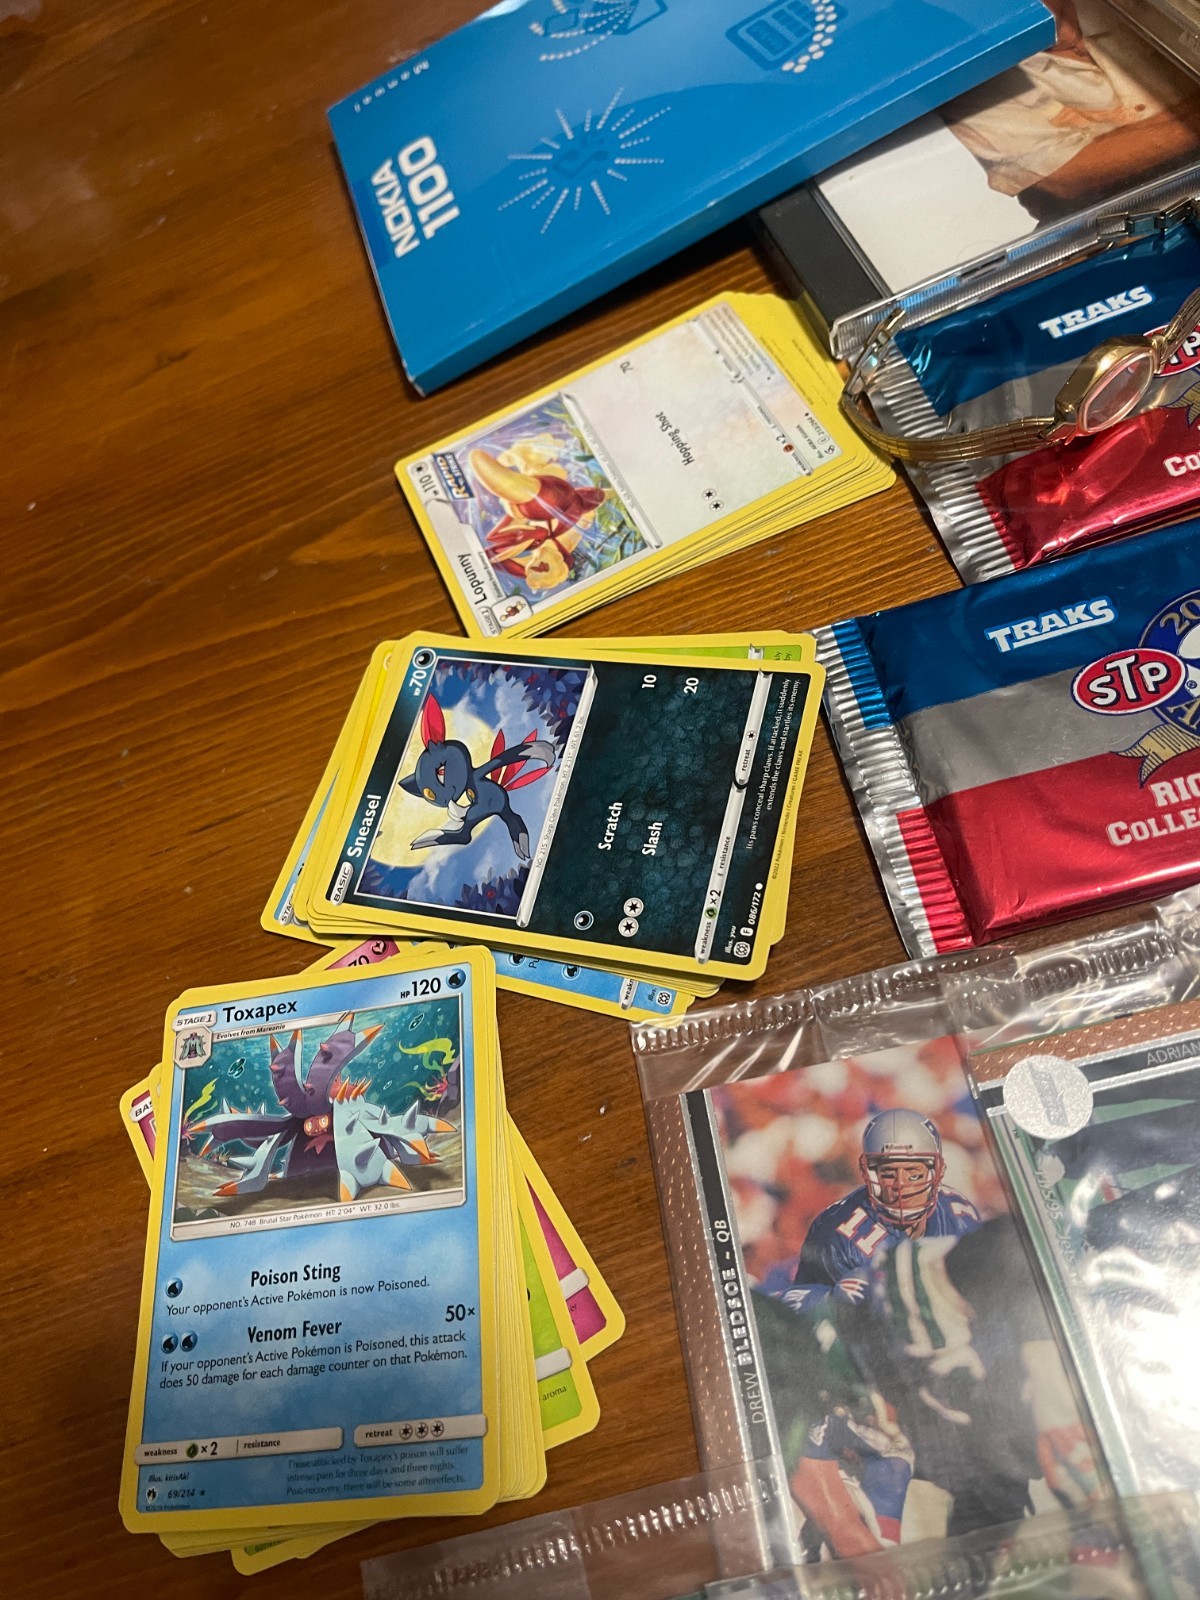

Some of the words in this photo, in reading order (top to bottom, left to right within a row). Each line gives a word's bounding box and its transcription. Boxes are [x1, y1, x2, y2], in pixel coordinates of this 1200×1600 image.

[398, 136, 461, 240] 1100
[371, 158, 420, 258] NOKIA
[1040, 286, 1154, 339] TRAKS
[620, 361, 632, 373] 70
[653, 411, 673, 432] Shot
[665, 429, 694, 465] Hopping
[419, 475, 435, 492] 110
[436, 452, 469, 500] RAPID
[458, 554, 487, 604] Lopunny
[989, 599, 1115, 653] TRAKS
[409, 670, 428, 687] 70
[642, 675, 656, 688] 10
[683, 676, 700, 693] 20
[1089, 654, 1168, 706] STP
[783, 712, 792, 736] startles
[748, 820, 759, 839] paws
[754, 793, 764, 820] conceal
[759, 773, 770, 792] sharp
[779, 679, 791, 708] suddenly
[779, 737, 787, 750] and
[742, 749, 750, 771] retreat
[771, 770, 779, 781] the
[774, 751, 783, 769] claws
[767, 782, 777, 810] extends
[347, 795, 380, 857] Sneasel
[598, 803, 622, 849] Scratch
[642, 823, 662, 855] Slash
[1107, 806, 1200, 846] COLLE
[540, 843, 548, 855] 215
[720, 836, 730, 868] resistance
[334, 868, 349, 901] BASIC
[746, 891, 761, 925] 086/172
[701, 922, 711, 954] weakness
[400, 991, 410, 999] HP
[412, 977, 441, 996] 120
[223, 1001, 296, 1022] Toxapex
[714, 1219, 730, 1242] QB
[837, 1207, 887, 1255] 11
[251, 1270, 297, 1286] Poison
[303, 1264, 340, 1282] Sting
[167, 1305, 190, 1315] Your
[193, 1297, 248, 1315] opponent's
[251, 1295, 283, 1306] Active
[287, 1289, 335, 1302] Pokémon
[340, 1286, 347, 1296] is
[351, 1285, 374, 1294] now
[378, 1276, 429, 1291] Poisoned.
[248, 1327, 296, 1342] Venom
[303, 1321, 341, 1337] Fever
[722, 1267, 752, 1366] BLEDSOE
[161, 1361, 168, 1372] If
[170, 1362, 193, 1374] your
[197, 1353, 252, 1371] opponent's
[255, 1350, 288, 1362] Active
[292, 1346, 341, 1358] Pokémon
[344, 1342, 352, 1353] is
[356, 1337, 407, 1351] Poisoned,
[410, 1334, 429, 1346] this
[432, 1330, 465, 1344] attack
[159, 1377, 183, 1389] does
[186, 1374, 199, 1386] 50
[202, 1373, 239, 1385] damage
[242, 1369, 257, 1380] for
[260, 1366, 283, 1378] each
[287, 1364, 325, 1376] damage
[329, 1360, 369, 1371] counter
[373, 1358, 386, 1367] on
[390, 1354, 411, 1365] that
[414, 1350, 467, 1363] Pokémon.
[542, 1386, 567, 1401] aroma
[746, 1372, 765, 1424] DREW
[244, 1440, 280, 1448] resistance
[365, 1429, 392, 1438] retreat
[168, 1489, 195, 1498] 69/214
